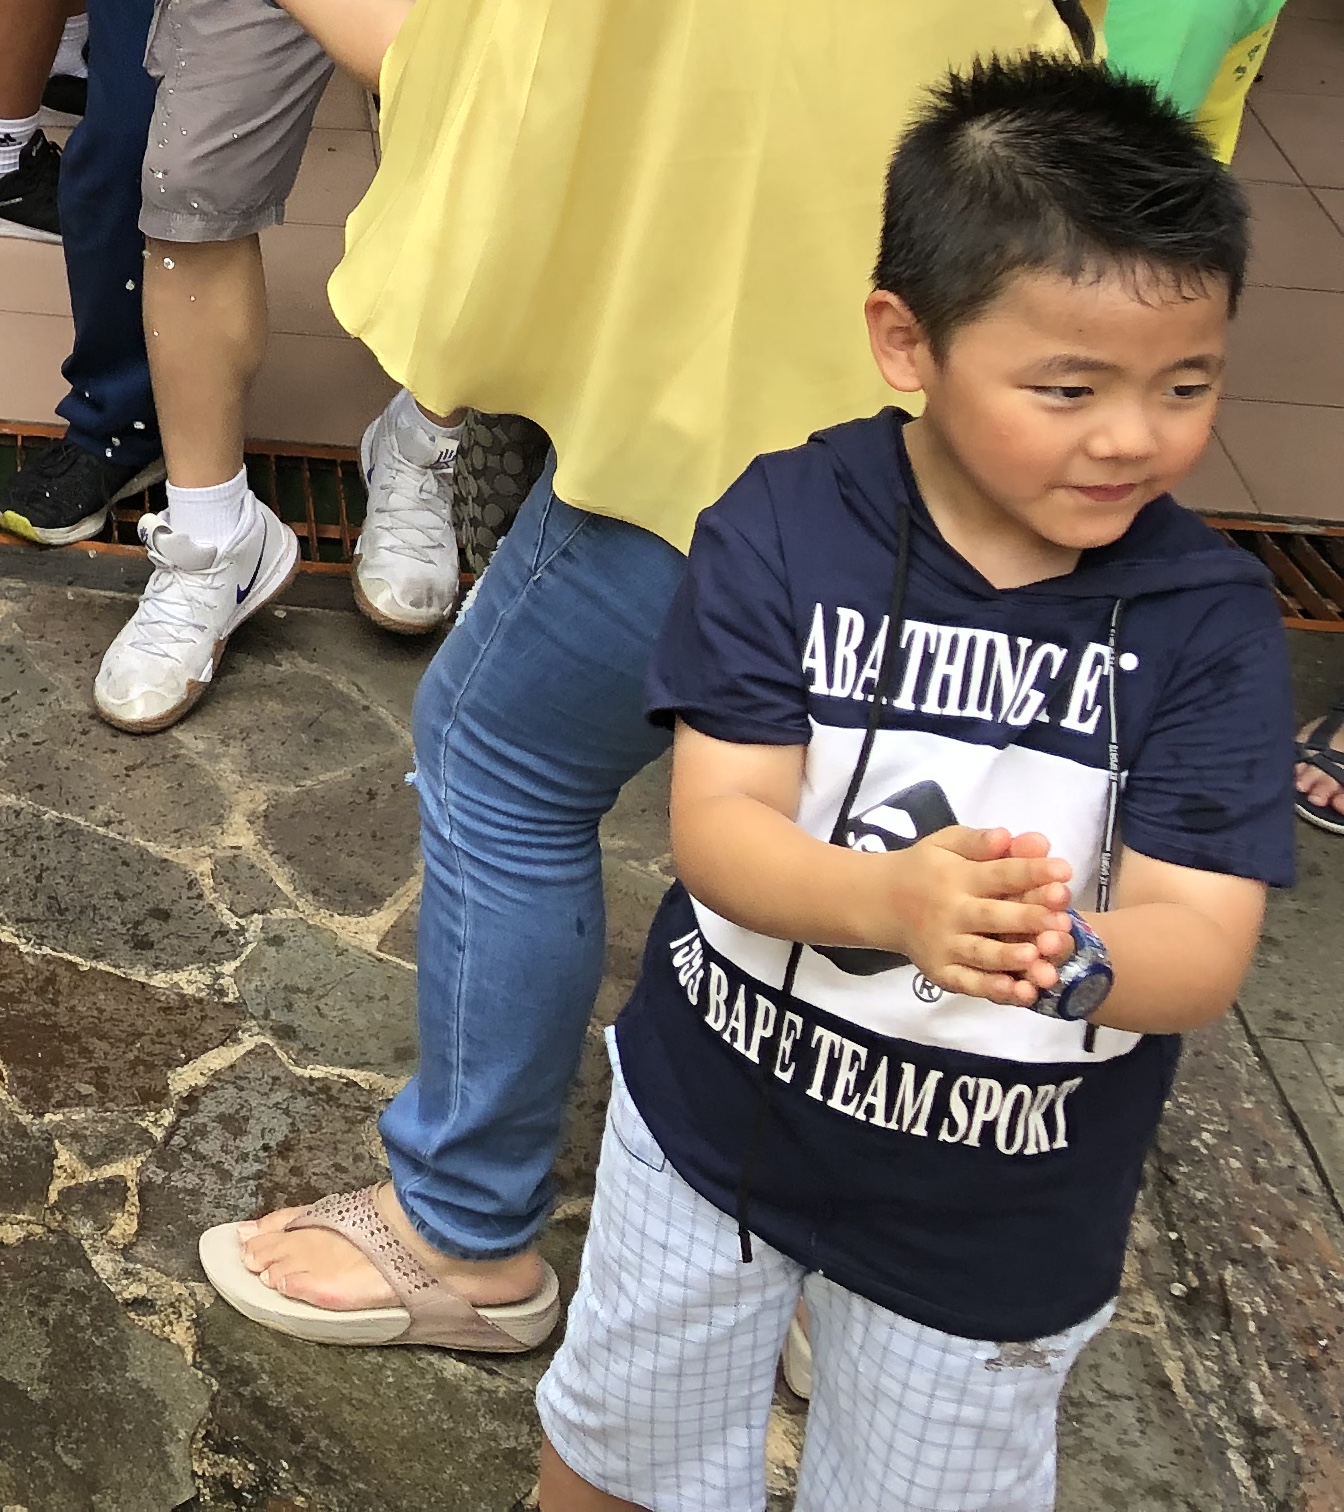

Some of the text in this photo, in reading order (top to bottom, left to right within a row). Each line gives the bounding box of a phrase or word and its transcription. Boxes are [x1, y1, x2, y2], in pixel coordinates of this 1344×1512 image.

[703, 960, 802, 1084] BAPE
[806, 1024, 944, 1137] TEAM
[937, 1074, 1084, 1157] SPORT
